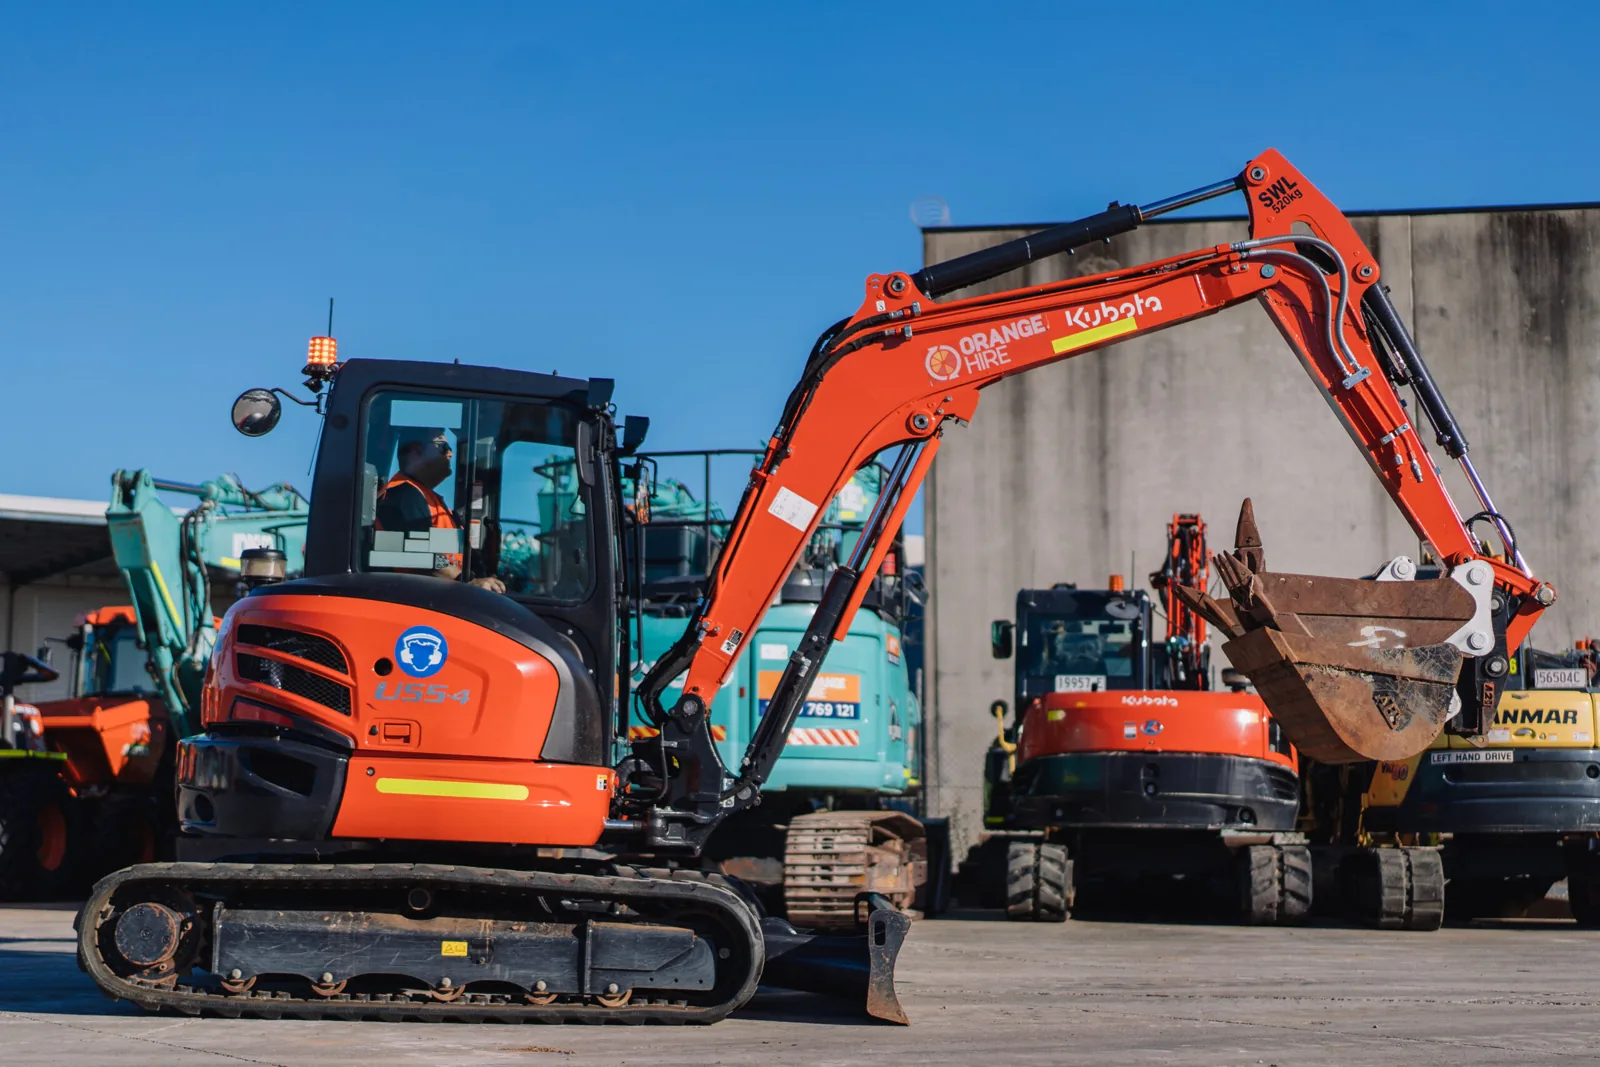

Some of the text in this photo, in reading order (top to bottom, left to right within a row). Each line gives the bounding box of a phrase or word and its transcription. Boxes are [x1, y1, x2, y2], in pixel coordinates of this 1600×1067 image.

[1258, 176, 1298, 208] SWL
[1271, 188, 1303, 214] 520kg
[1064, 293, 1163, 329] Kubota
[959, 315, 1046, 355] ORANGE
[964, 345, 1011, 375] HIRE
[806, 703, 834, 716] 769
[835, 704, 855, 717] 121
[1121, 695, 1179, 707] Kubota
[1432, 751, 1512, 763] LEFT HAND DRIVE
